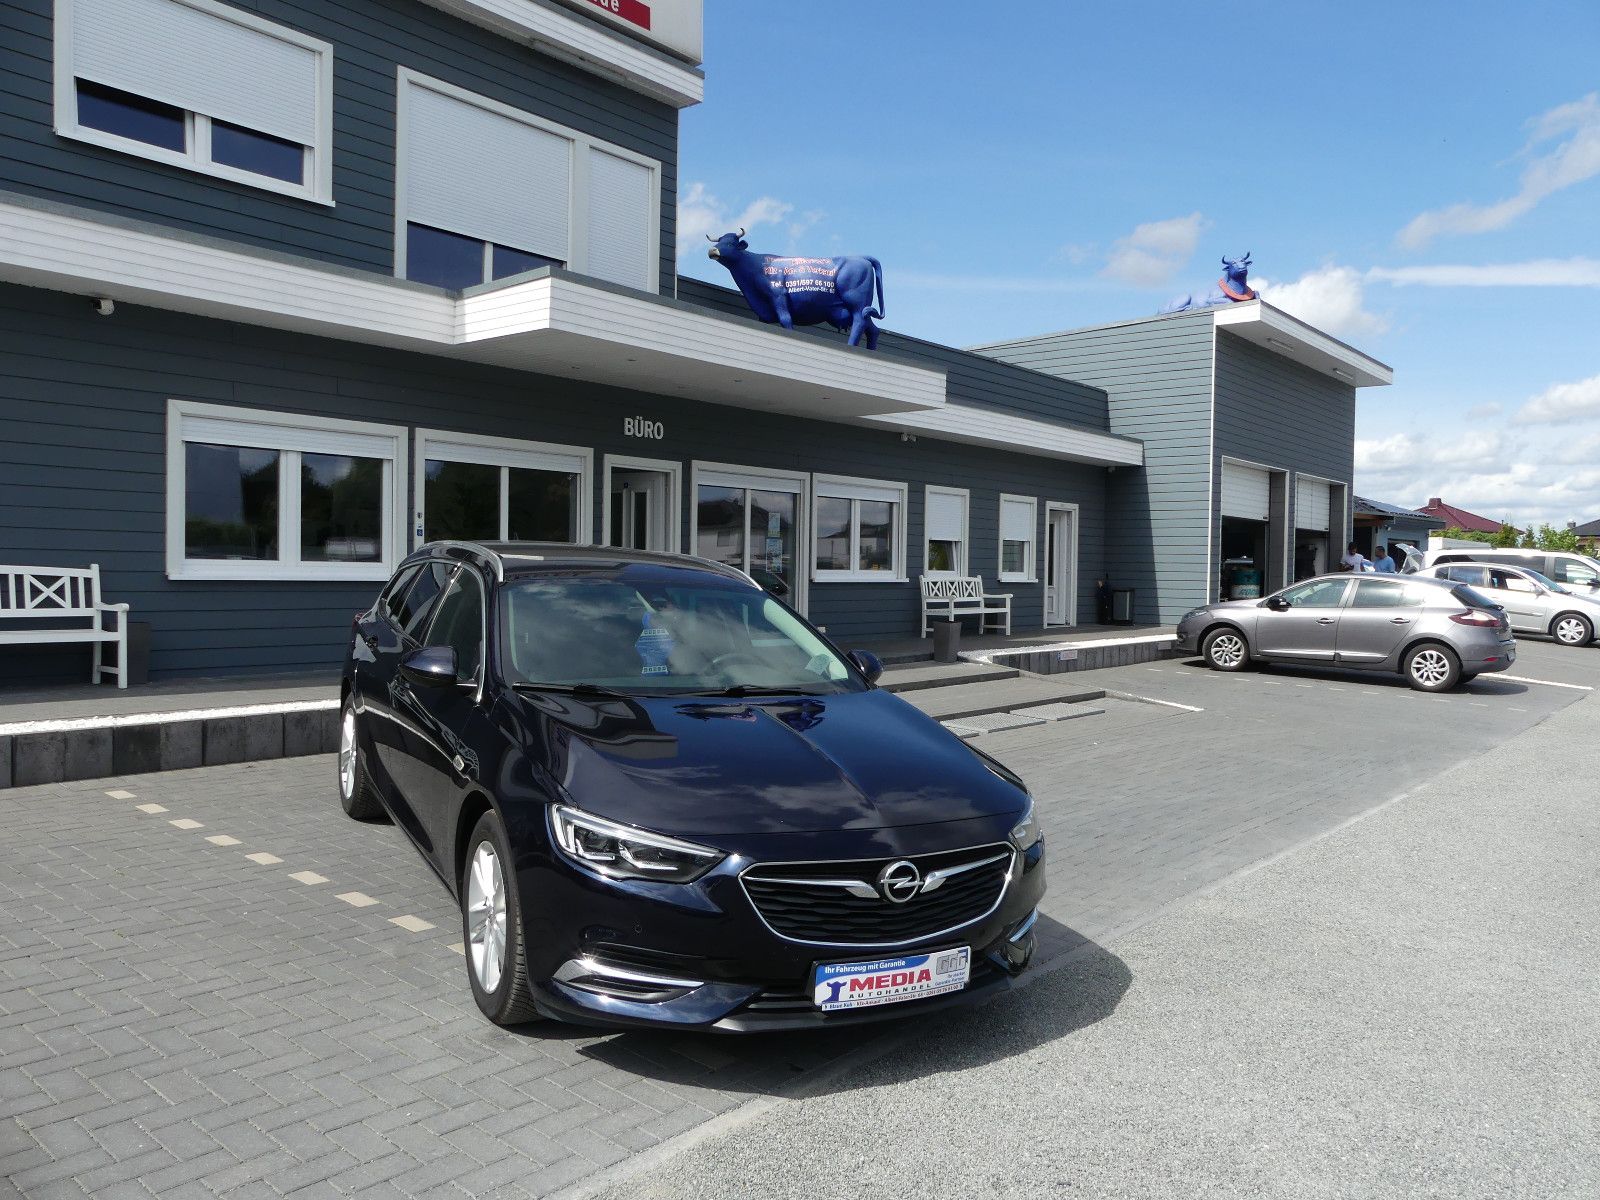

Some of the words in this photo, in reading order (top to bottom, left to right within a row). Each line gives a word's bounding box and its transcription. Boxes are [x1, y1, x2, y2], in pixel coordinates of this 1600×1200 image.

[623, 415, 664, 440] BÜRO
[824, 966, 836, 974] Ihr
[835, 965, 867, 974] Fahrzeug
[867, 962, 879, 970] mit
[879, 959, 907, 969] Garantie
[849, 969, 932, 992] MEDIA
[848, 983, 931, 999] AUTOHANDEL
